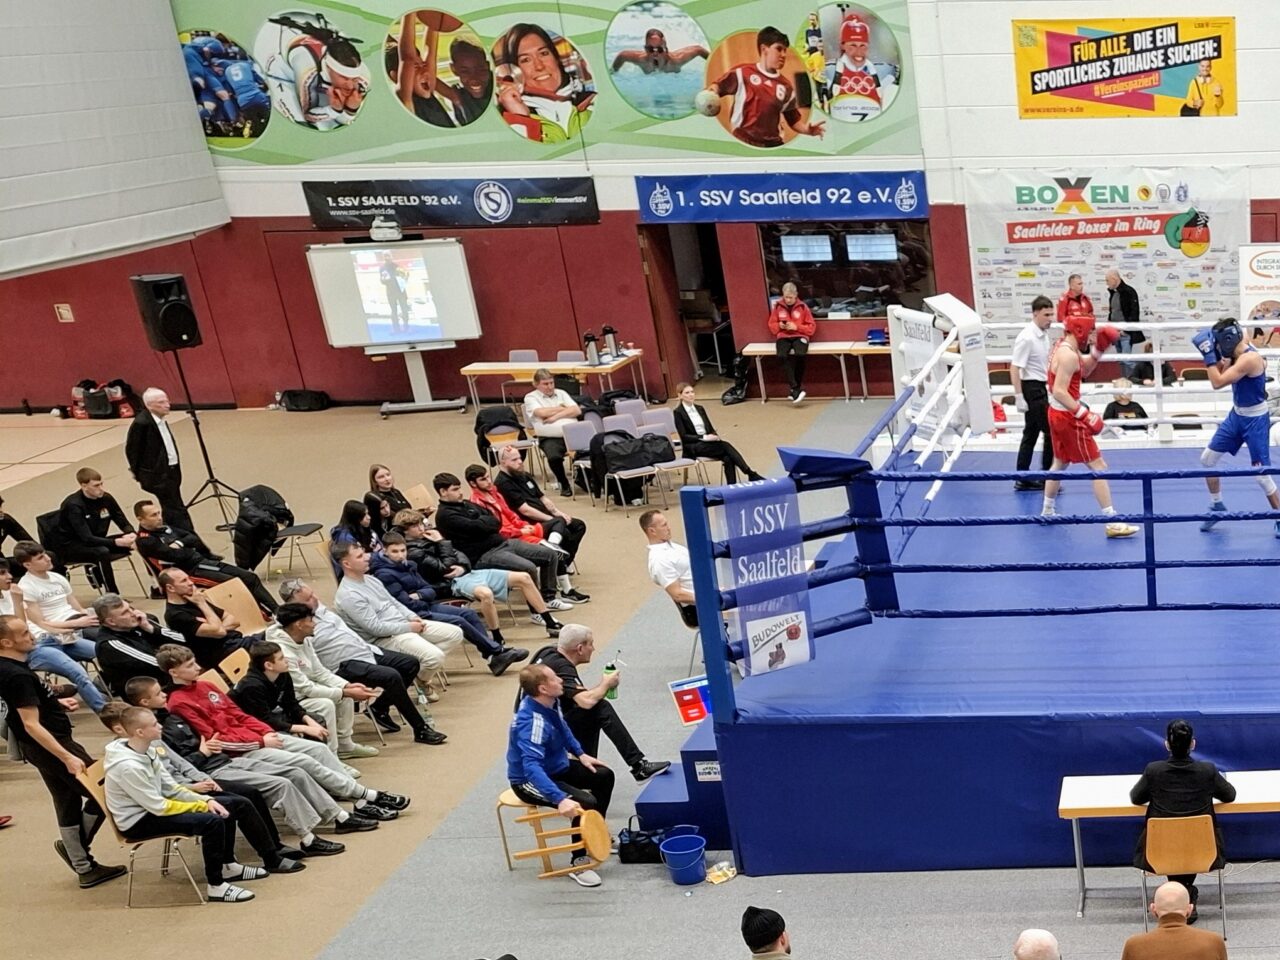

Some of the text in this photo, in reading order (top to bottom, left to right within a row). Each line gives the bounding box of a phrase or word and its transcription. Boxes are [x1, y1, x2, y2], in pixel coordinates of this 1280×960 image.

[1073, 27, 1176, 62] FÜR ALLE, DIE EIN
[231, 66, 243, 82] 5
[1033, 39, 1218, 91] SPORTLICHES ZUHAUSE SUCHEN:
[776, 84, 787, 100] 6
[326, 196, 336, 207] 1.
[337, 196, 360, 207] SSV
[361, 195, 420, 206] SAALFELD
[440, 195, 461, 206] e.V.
[676, 187, 892, 207] 1. SSV Saalfeld 92 e.V.
[1015, 177, 1129, 215] BOXEN
[1013, 216, 1161, 240] Saalfelder Boxer im Ring
[740, 503, 790, 537] 1.SSV
[738, 548, 800, 584] Saalfeld
[751, 613, 801, 648] BUDOWELT
